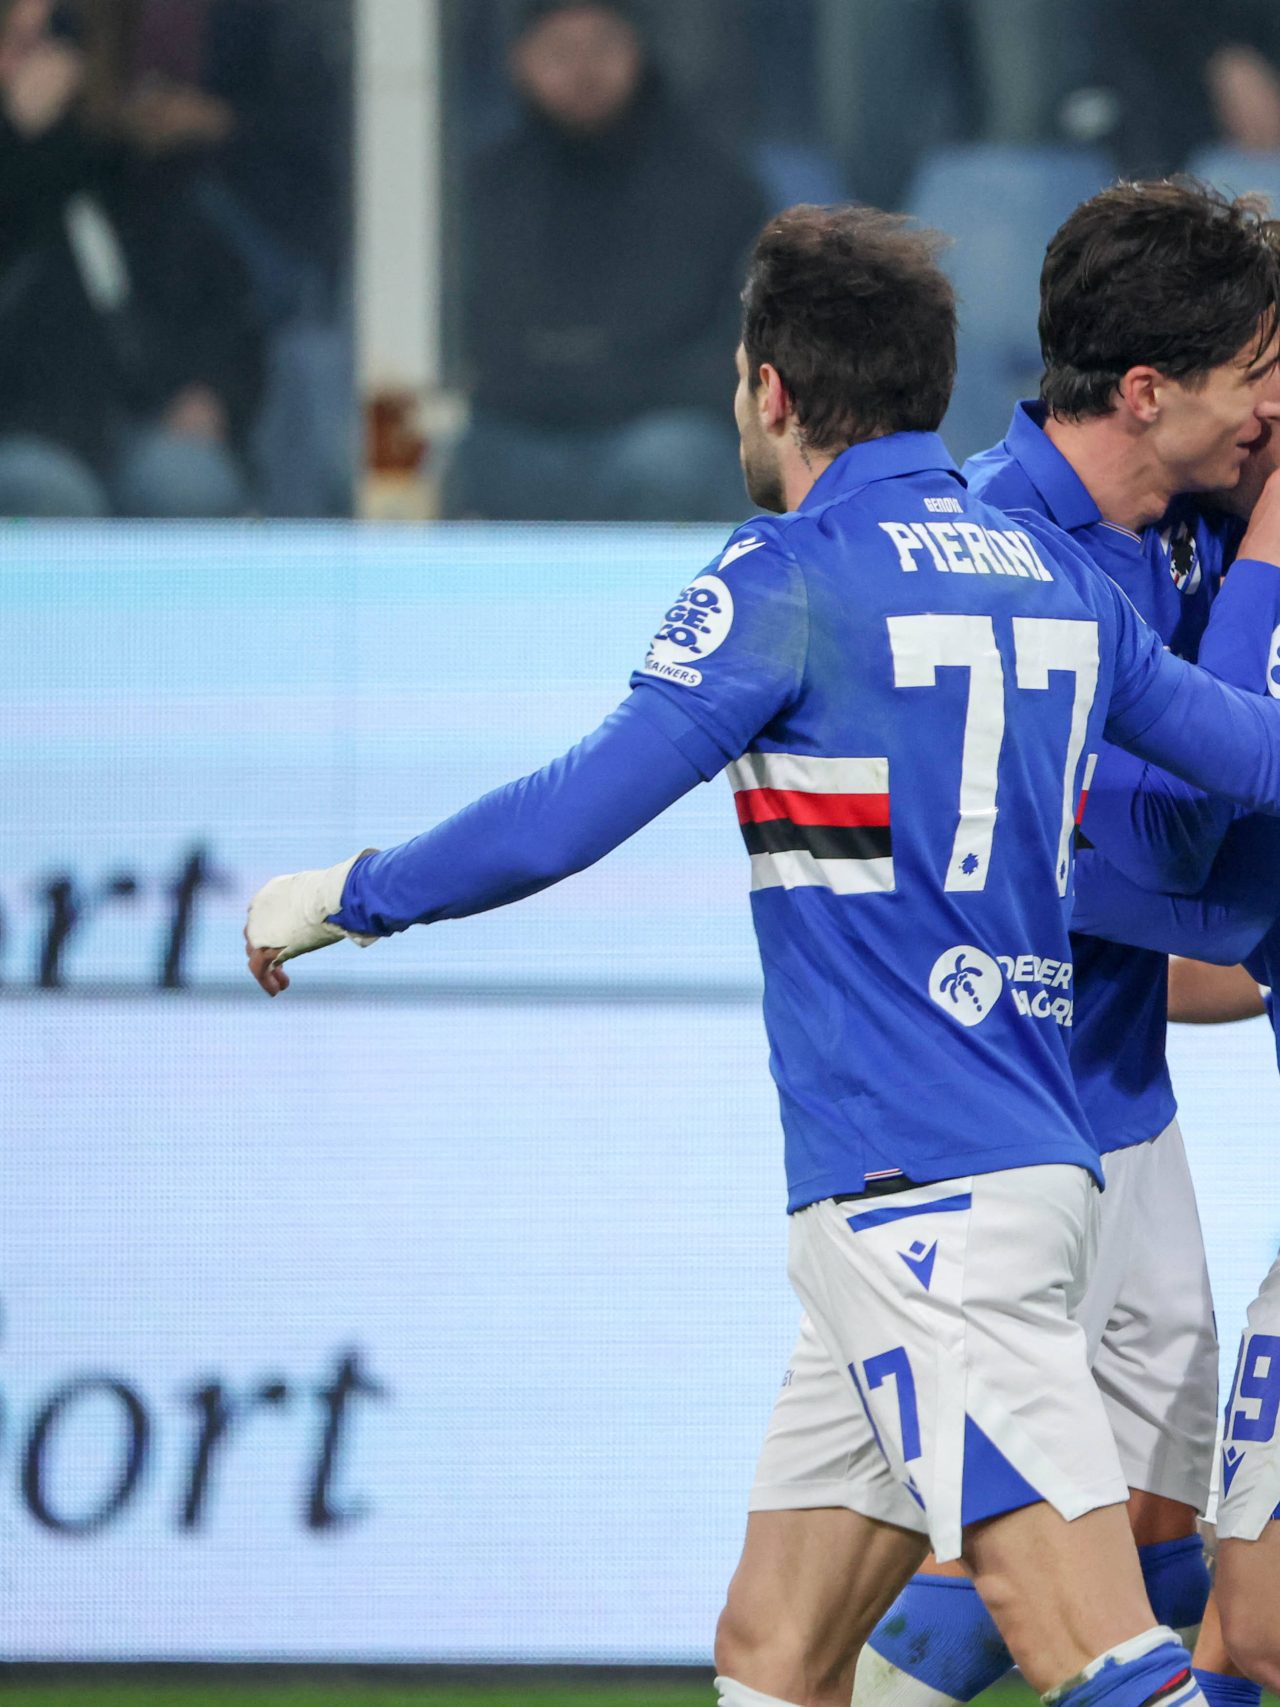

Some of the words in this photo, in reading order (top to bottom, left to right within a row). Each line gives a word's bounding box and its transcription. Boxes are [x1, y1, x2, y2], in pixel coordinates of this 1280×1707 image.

[878, 522, 1054, 582] PIERINI
[665, 604, 712, 634] GE.
[646, 659, 698, 684] AINERS
[886, 613, 1100, 898] 77
[18, 1345, 388, 1537] ort
